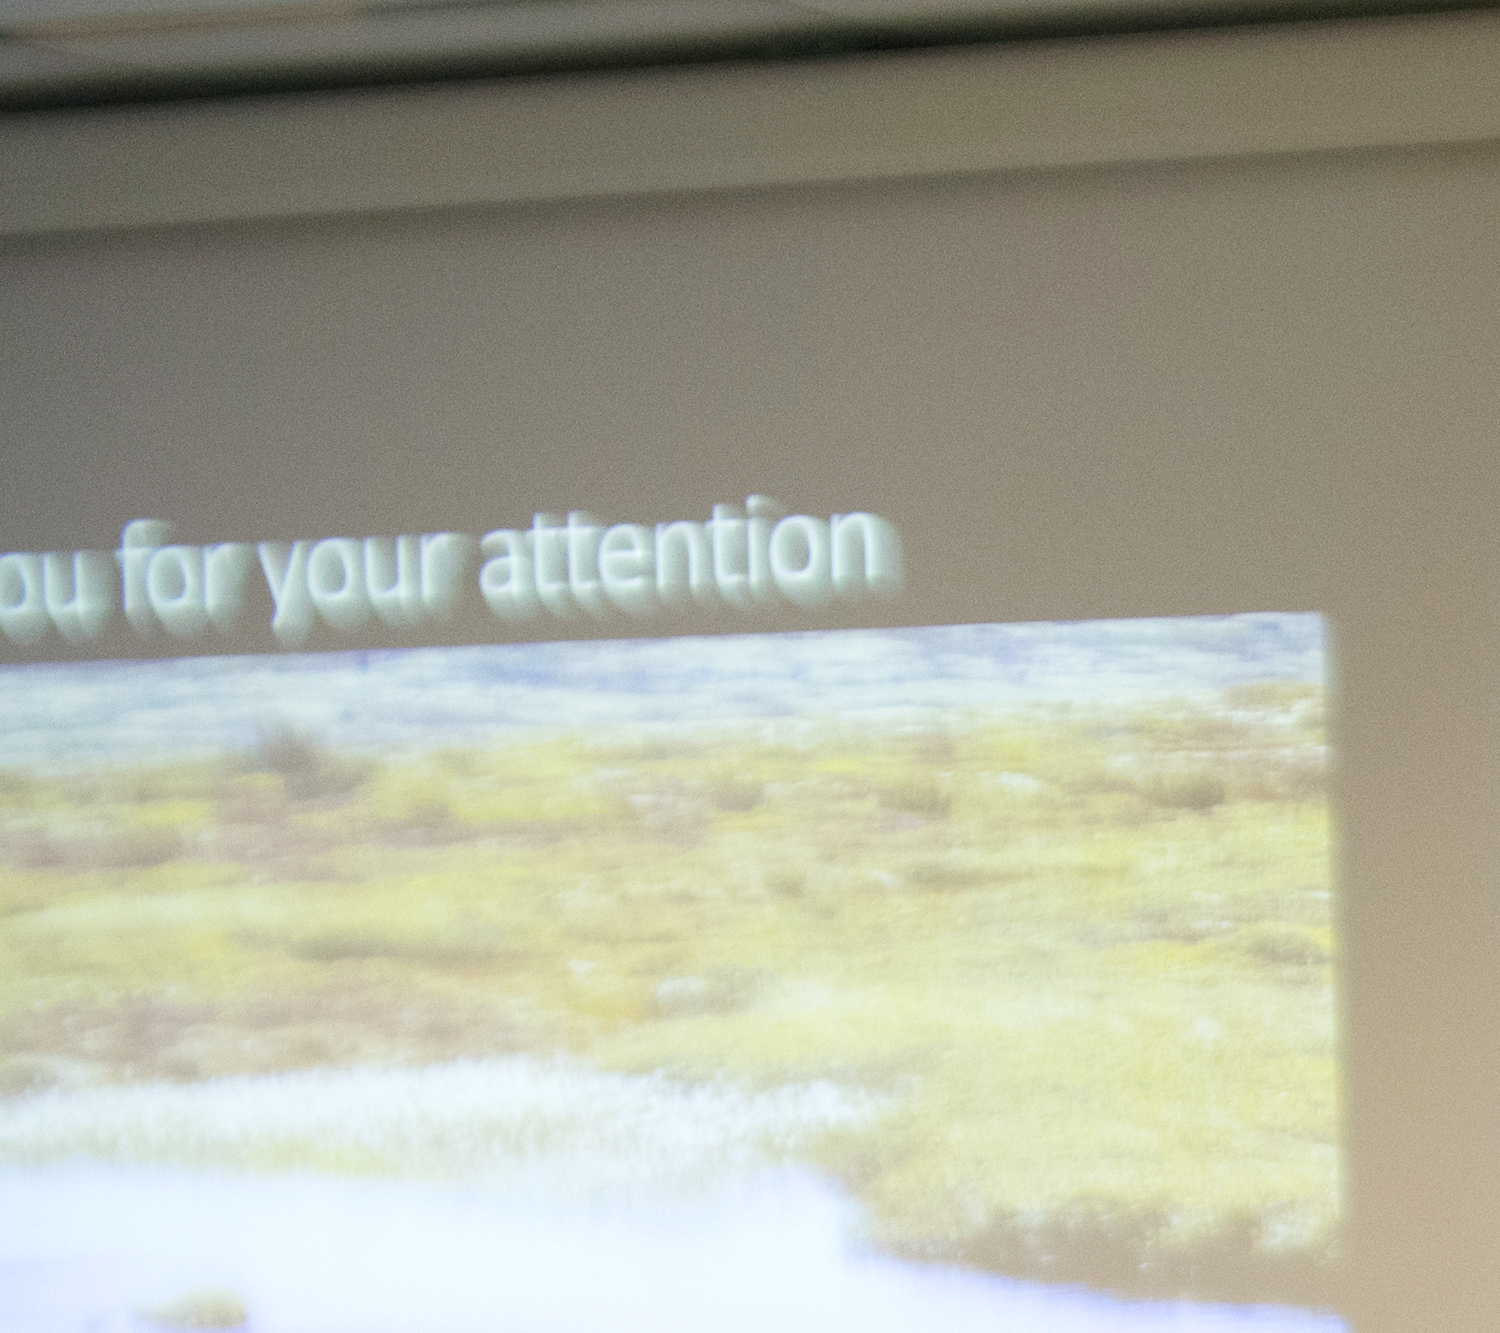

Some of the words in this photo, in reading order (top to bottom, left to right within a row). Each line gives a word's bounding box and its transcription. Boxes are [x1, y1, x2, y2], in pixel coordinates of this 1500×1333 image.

[0, 550, 110, 640] ou
[116, 518, 246, 634] for
[256, 531, 466, 645] your
[477, 494, 902, 622] attention
